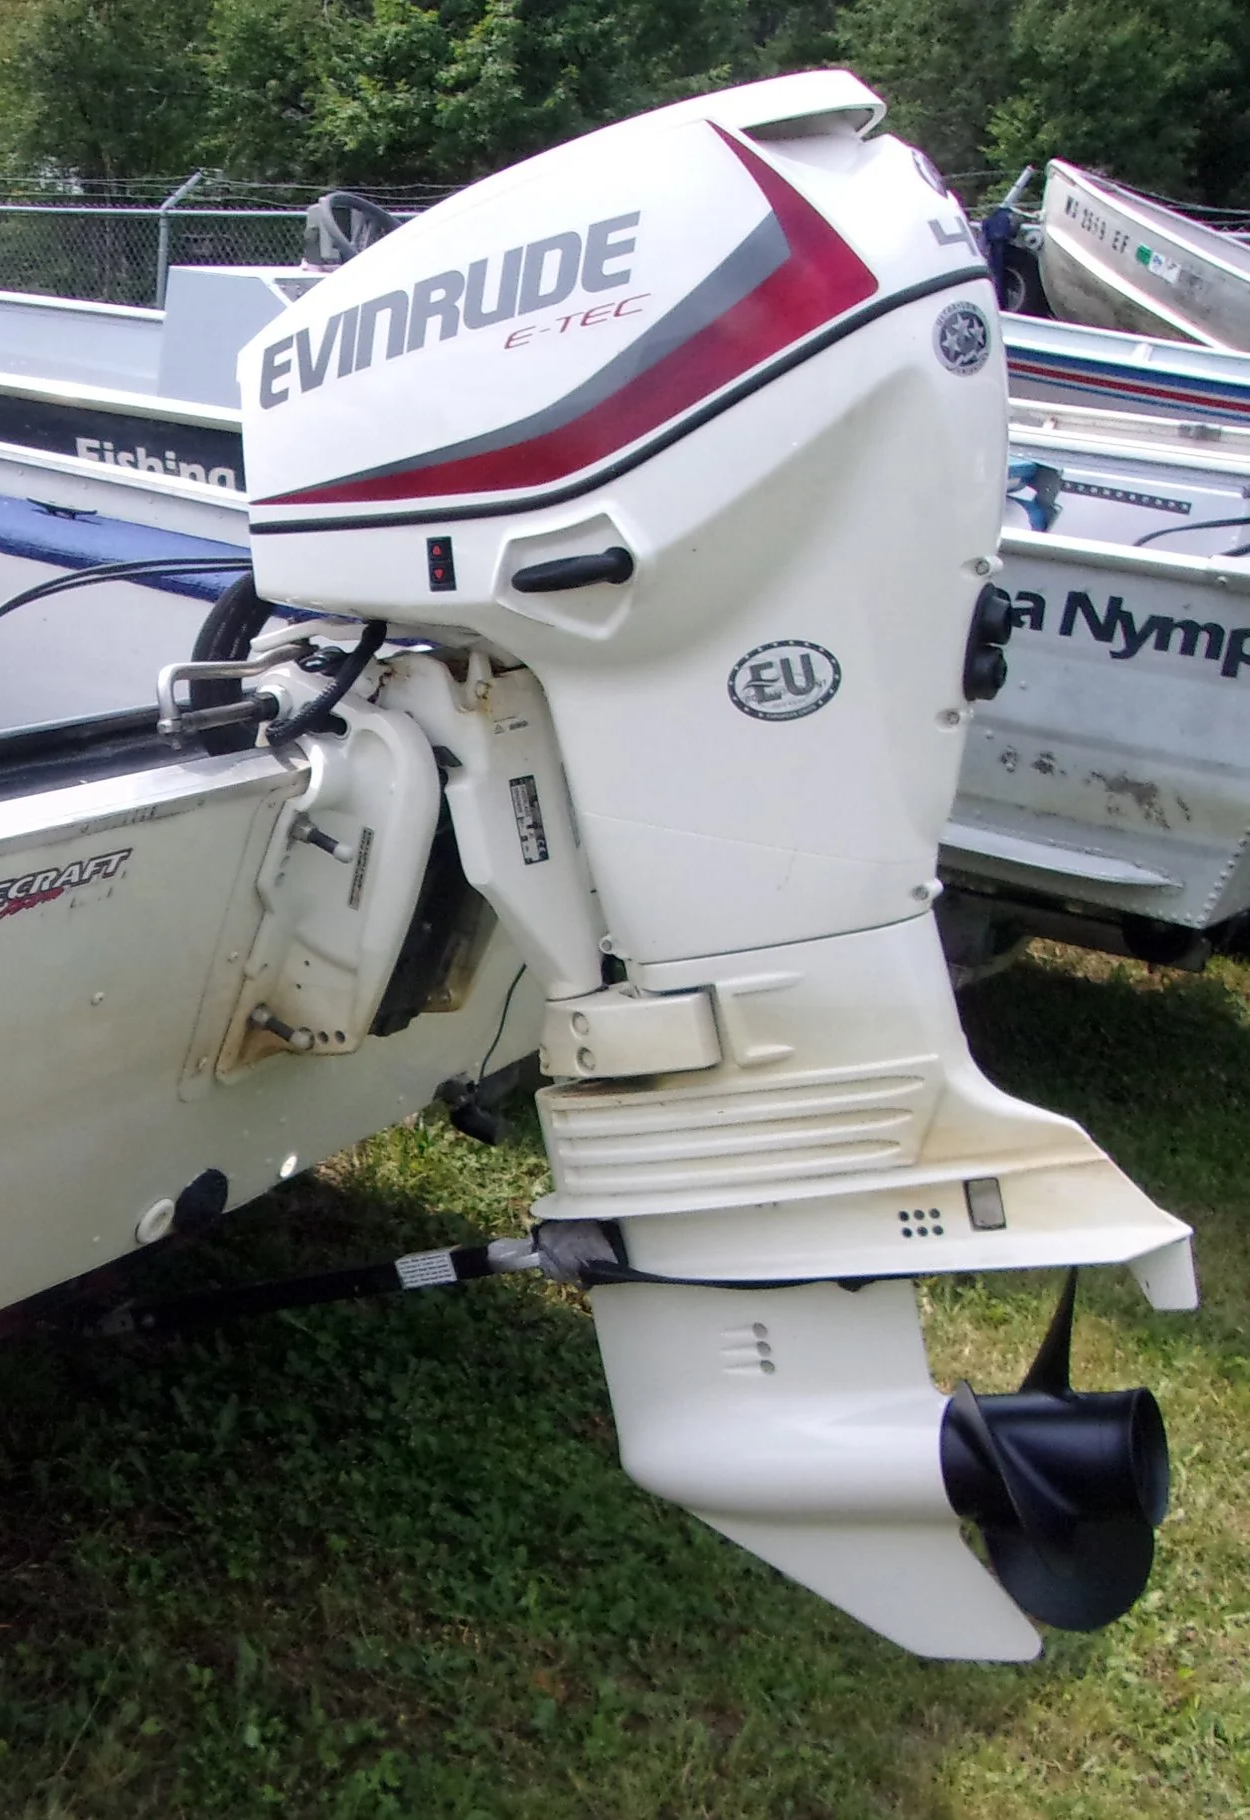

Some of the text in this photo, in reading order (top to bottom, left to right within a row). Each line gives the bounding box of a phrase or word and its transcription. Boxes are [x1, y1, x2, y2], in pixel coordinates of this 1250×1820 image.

[260, 211, 641, 409] EVINRUDE
[504, 293, 651, 350] E-TEC
[997, 588, 1046, 632] a
[747, 653, 816, 704] EU
